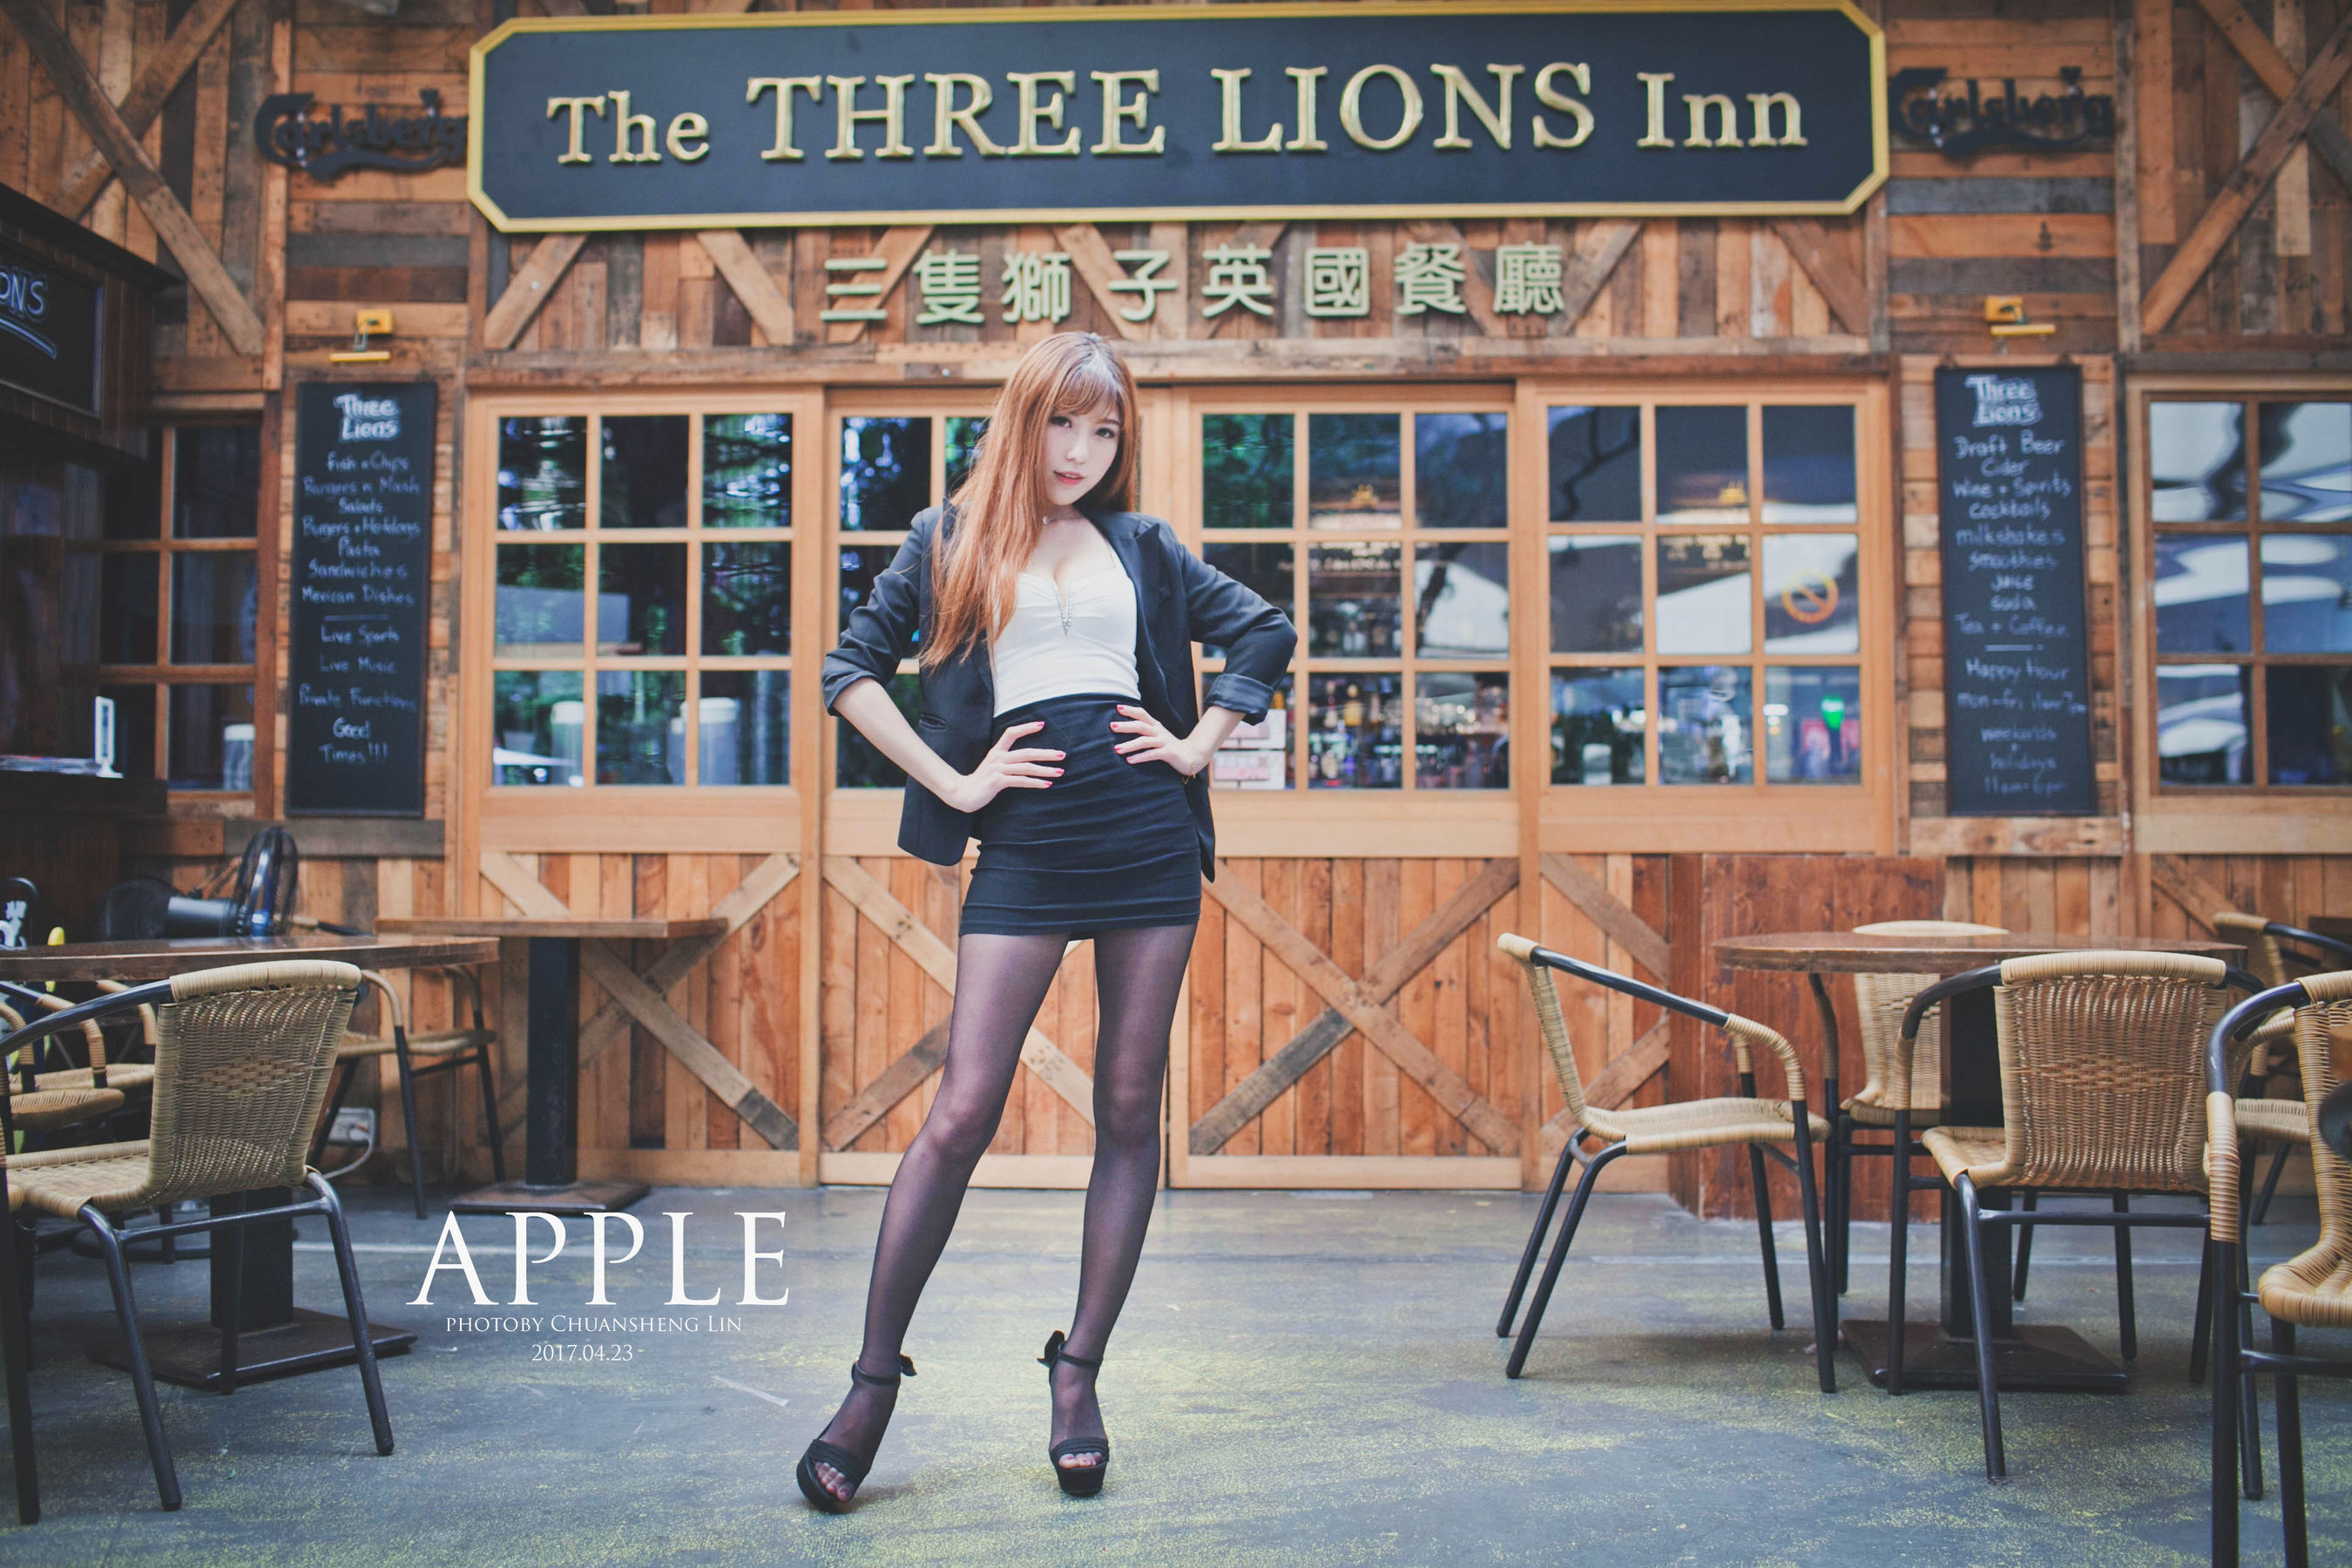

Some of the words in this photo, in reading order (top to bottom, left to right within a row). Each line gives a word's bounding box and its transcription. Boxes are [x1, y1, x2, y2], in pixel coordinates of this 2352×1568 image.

[546, 91, 710, 163] The
[746, 68, 1166, 159] THREE
[1211, 63, 1594, 152] LIONS
[1637, 72, 1808, 147] Inn
[1888, 66, 2115, 159] Carlsberg
[254, 88, 469, 181] Carlsberg
[820, 240, 1565, 326] 三隻獅子英國餐廳
[1964, 375, 2037, 402] Three
[334, 393, 401, 419] Three
[1972, 402, 2043, 427] Lions
[340, 417, 401, 441] Lions
[1953, 434, 2007, 459] Draft
[2020, 429, 2065, 454] Beer
[370, 449, 409, 472] Chips
[1980, 457, 2031, 476] Cider
[338, 536, 382, 558] Pasta
[308, 558, 409, 579] Sandwiches
[302, 585, 355, 604] Mexican
[362, 584, 416, 606] Dishes
[321, 625, 353, 645] Live
[358, 624, 401, 647] Sports
[1954, 612, 1984, 635] Tea
[2009, 613, 2070, 638] Coffee
[320, 654, 348, 672] Live
[358, 656, 396, 674] Music
[1966, 657, 2021, 685] Happy
[2026, 658, 2071, 680] Hour
[334, 717, 371, 740] Good
